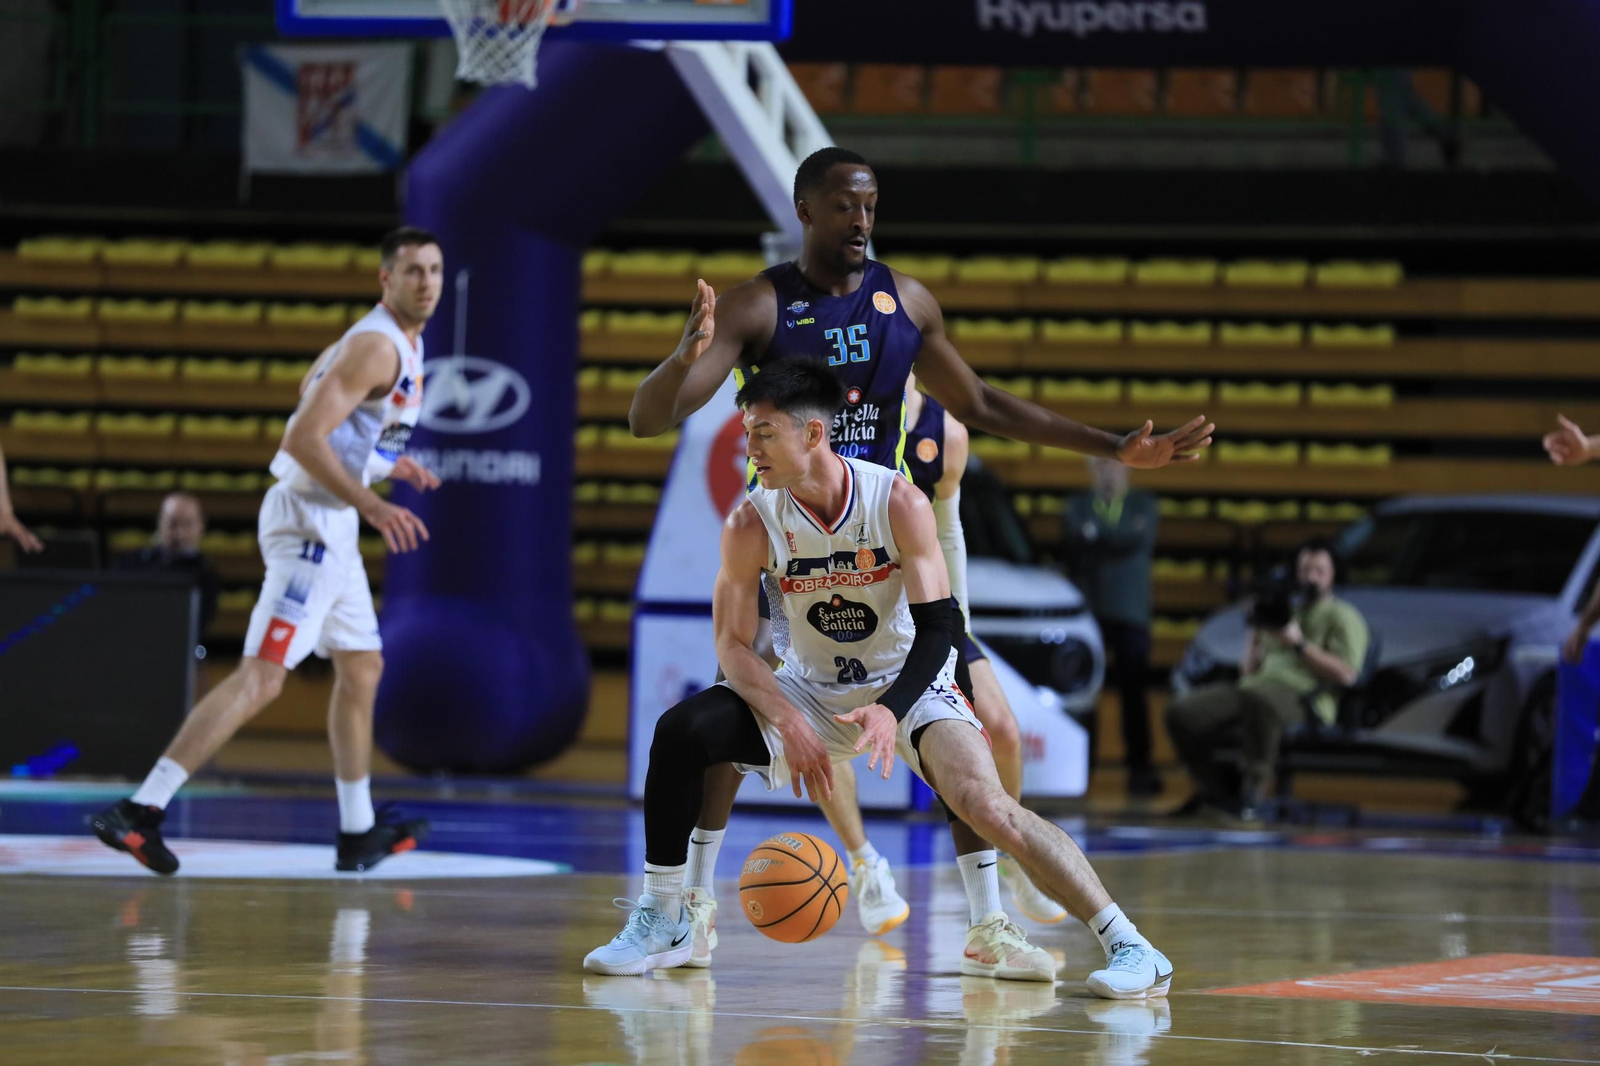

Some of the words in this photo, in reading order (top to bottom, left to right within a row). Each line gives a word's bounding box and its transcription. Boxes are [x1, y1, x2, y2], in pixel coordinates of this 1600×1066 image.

[977, 0, 1206, 36] Hyupersa
[824, 324, 871, 366] 35
[833, 403, 880, 428] stella
[792, 572, 874, 593] OBRADOIRO
[818, 607, 866, 621] Estrella
[820, 619, 866, 632] Galicia
[833, 655, 868, 684] 28
